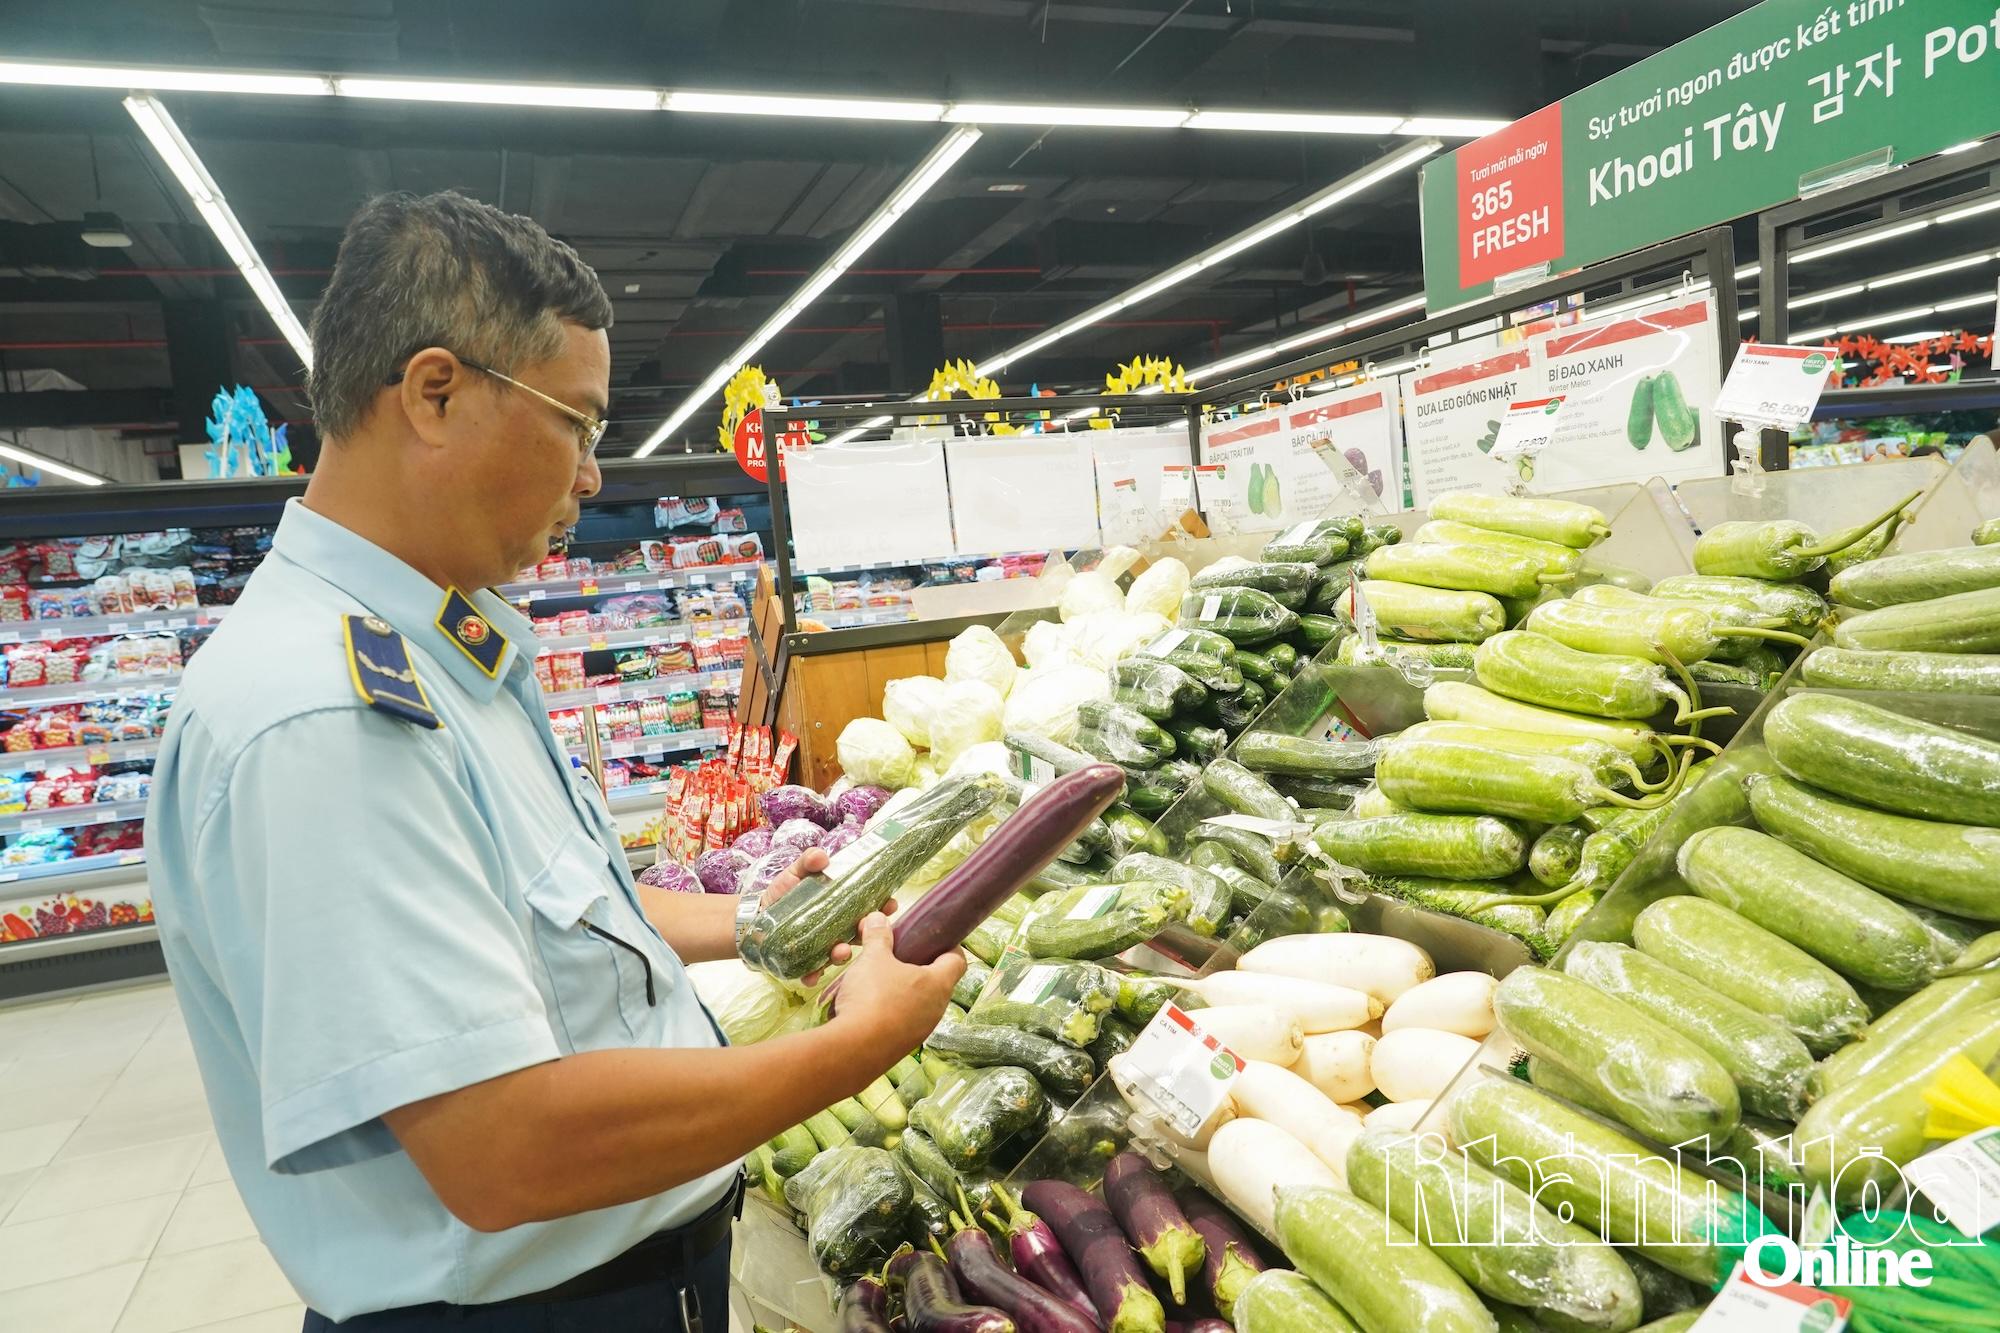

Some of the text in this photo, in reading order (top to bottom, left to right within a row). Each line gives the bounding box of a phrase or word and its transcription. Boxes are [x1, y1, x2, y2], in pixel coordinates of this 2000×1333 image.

[1588, 113, 1616, 140] Sự
[1619, 88, 1661, 127] tươi
[1667, 68, 1722, 106] ngon
[1727, 37, 1791, 80] được
[1797, 6, 1841, 51] kết
[1807, 43, 1901, 124] 감자
[1470, 140, 1548, 183] Tươi mới mỗi ngày
[1589, 102, 1786, 207] Khoai Tây
[1471, 180, 1513, 221] 365
[1472, 205, 1549, 260] FRESH
[1549, 354, 1623, 382] BÍ ĐAO XANH
[1417, 381, 1518, 417] DƯA LEO GIỐNG NHẬT
[1758, 401, 1809, 418] 26,900
